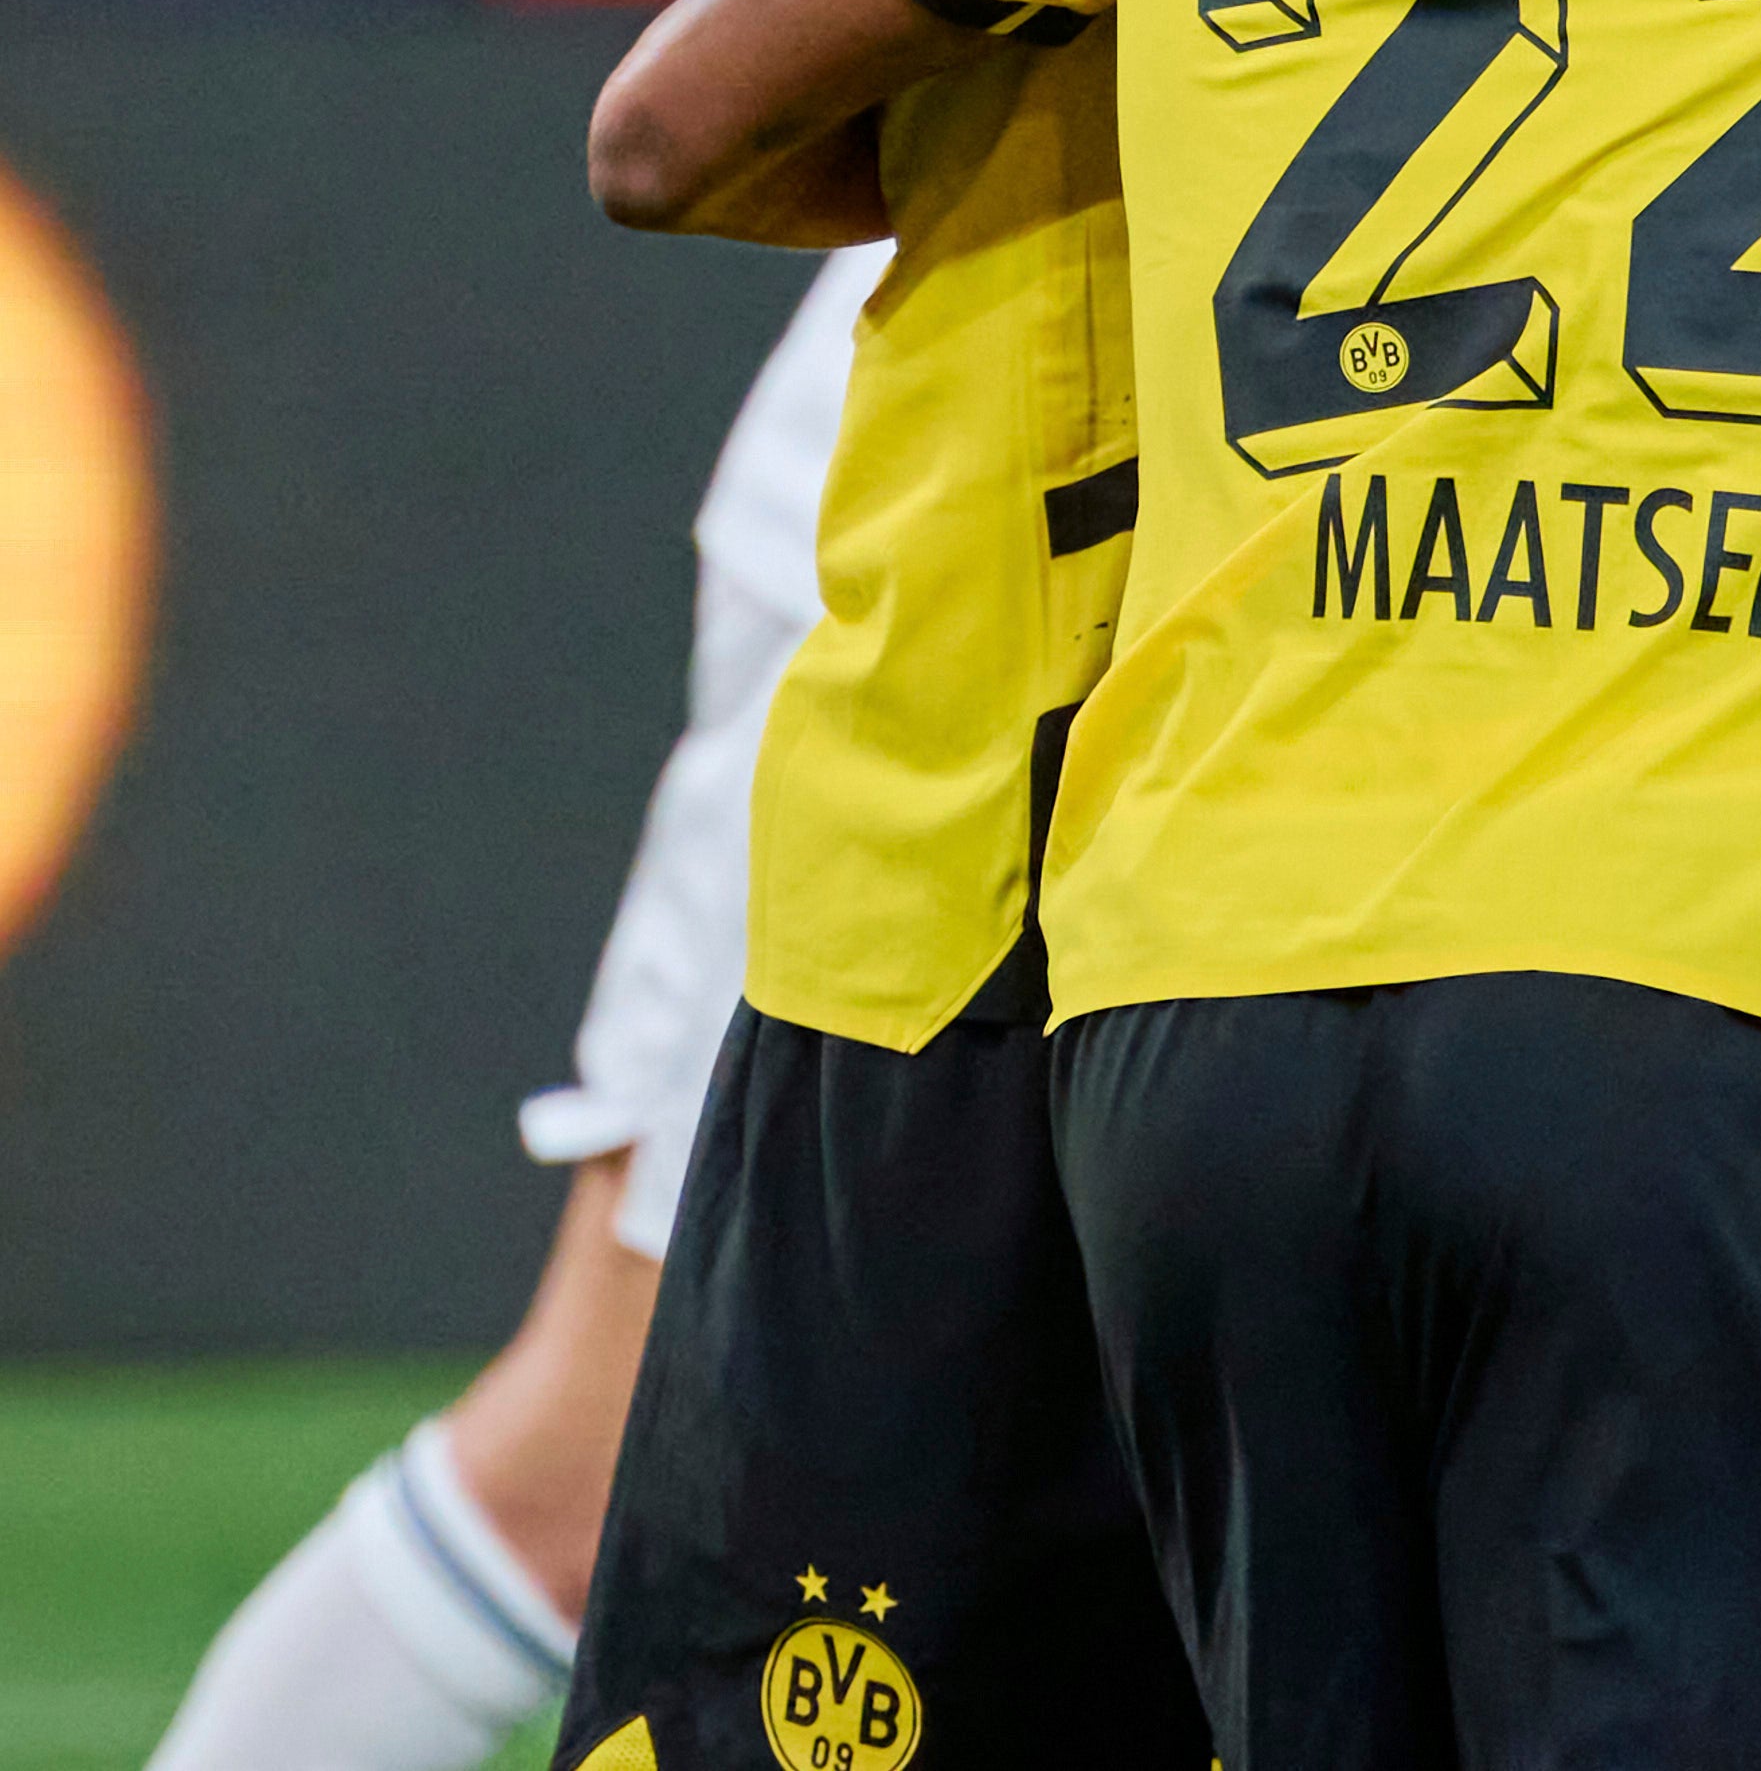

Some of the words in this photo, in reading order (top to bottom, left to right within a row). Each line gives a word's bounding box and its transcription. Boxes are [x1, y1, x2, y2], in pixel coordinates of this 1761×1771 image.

[1350, 330, 1400, 374] BVB
[1369, 369, 1388, 384] 09
[785, 1632, 900, 1749] BVB
[811, 1735, 854, 1771] 09
